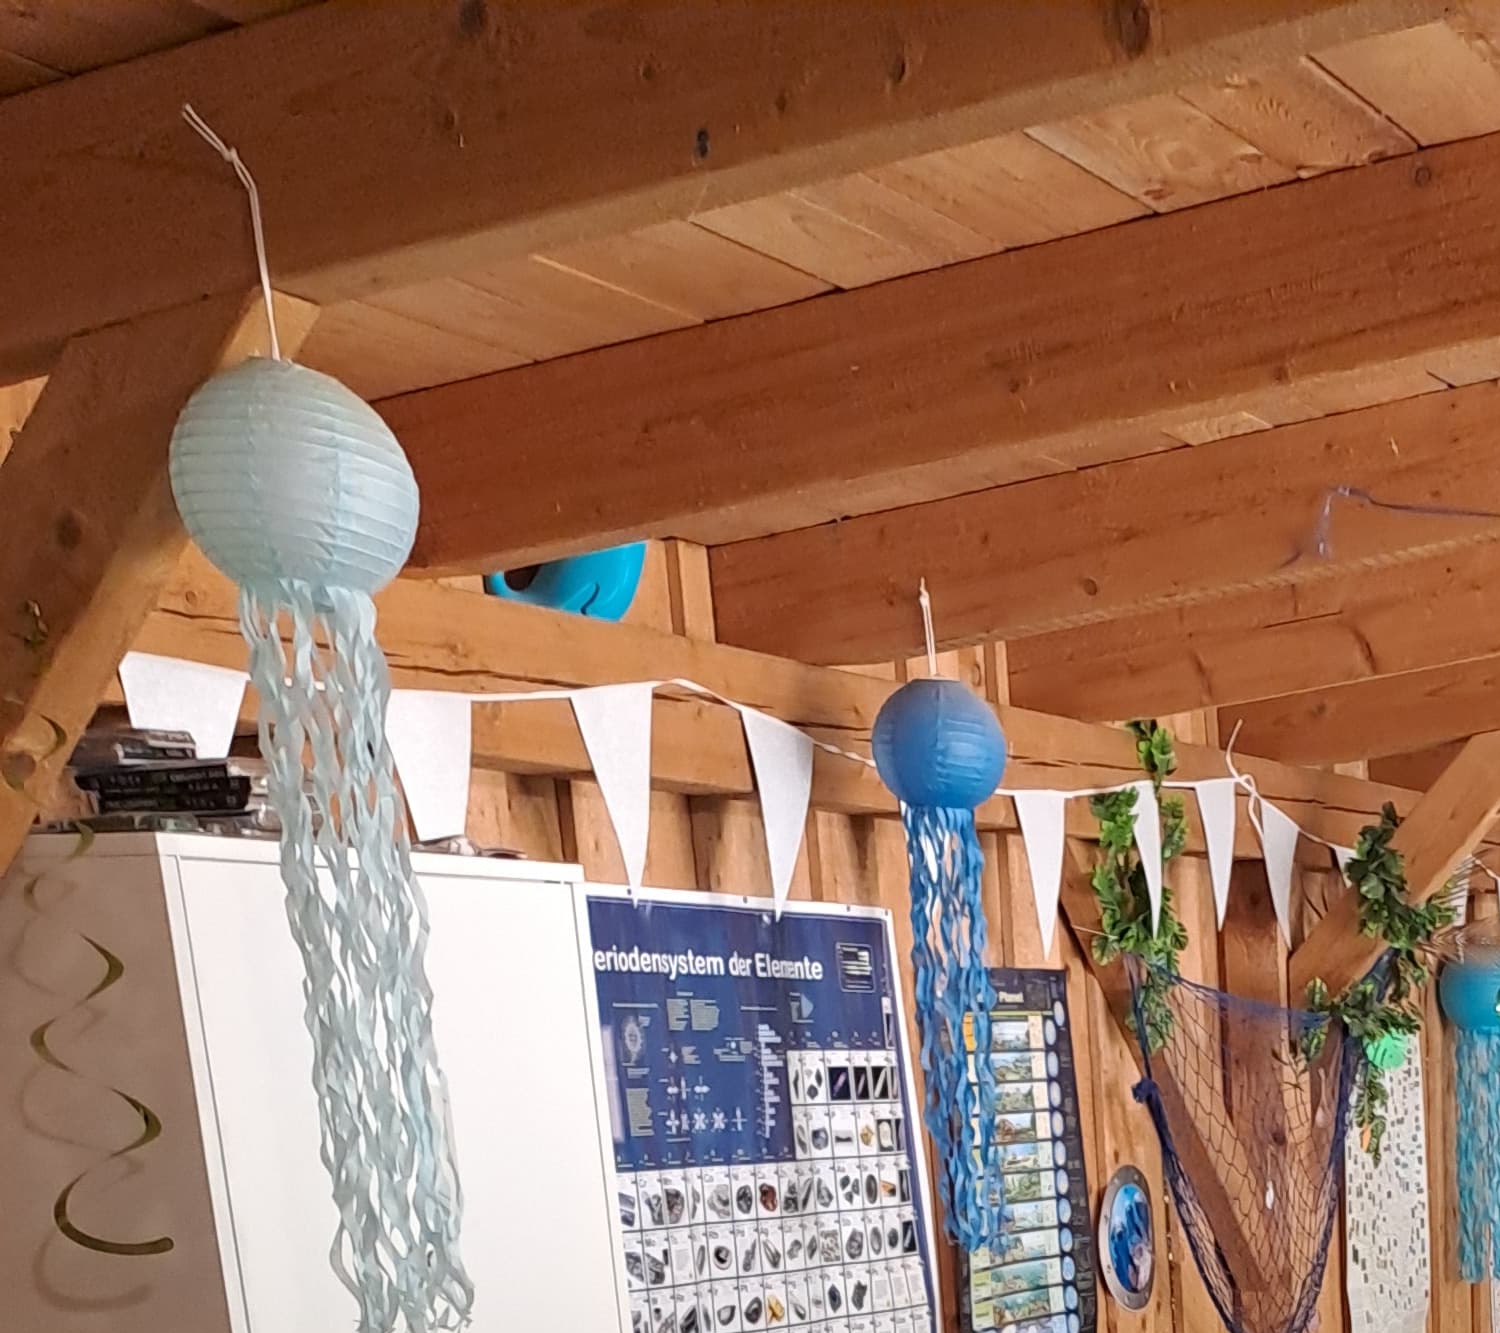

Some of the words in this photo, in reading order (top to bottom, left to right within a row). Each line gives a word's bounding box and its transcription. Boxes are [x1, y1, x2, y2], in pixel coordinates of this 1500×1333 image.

[592, 945, 725, 981] eriodensystem
[728, 951, 753, 977] der
[755, 953, 824, 981] Elemente
